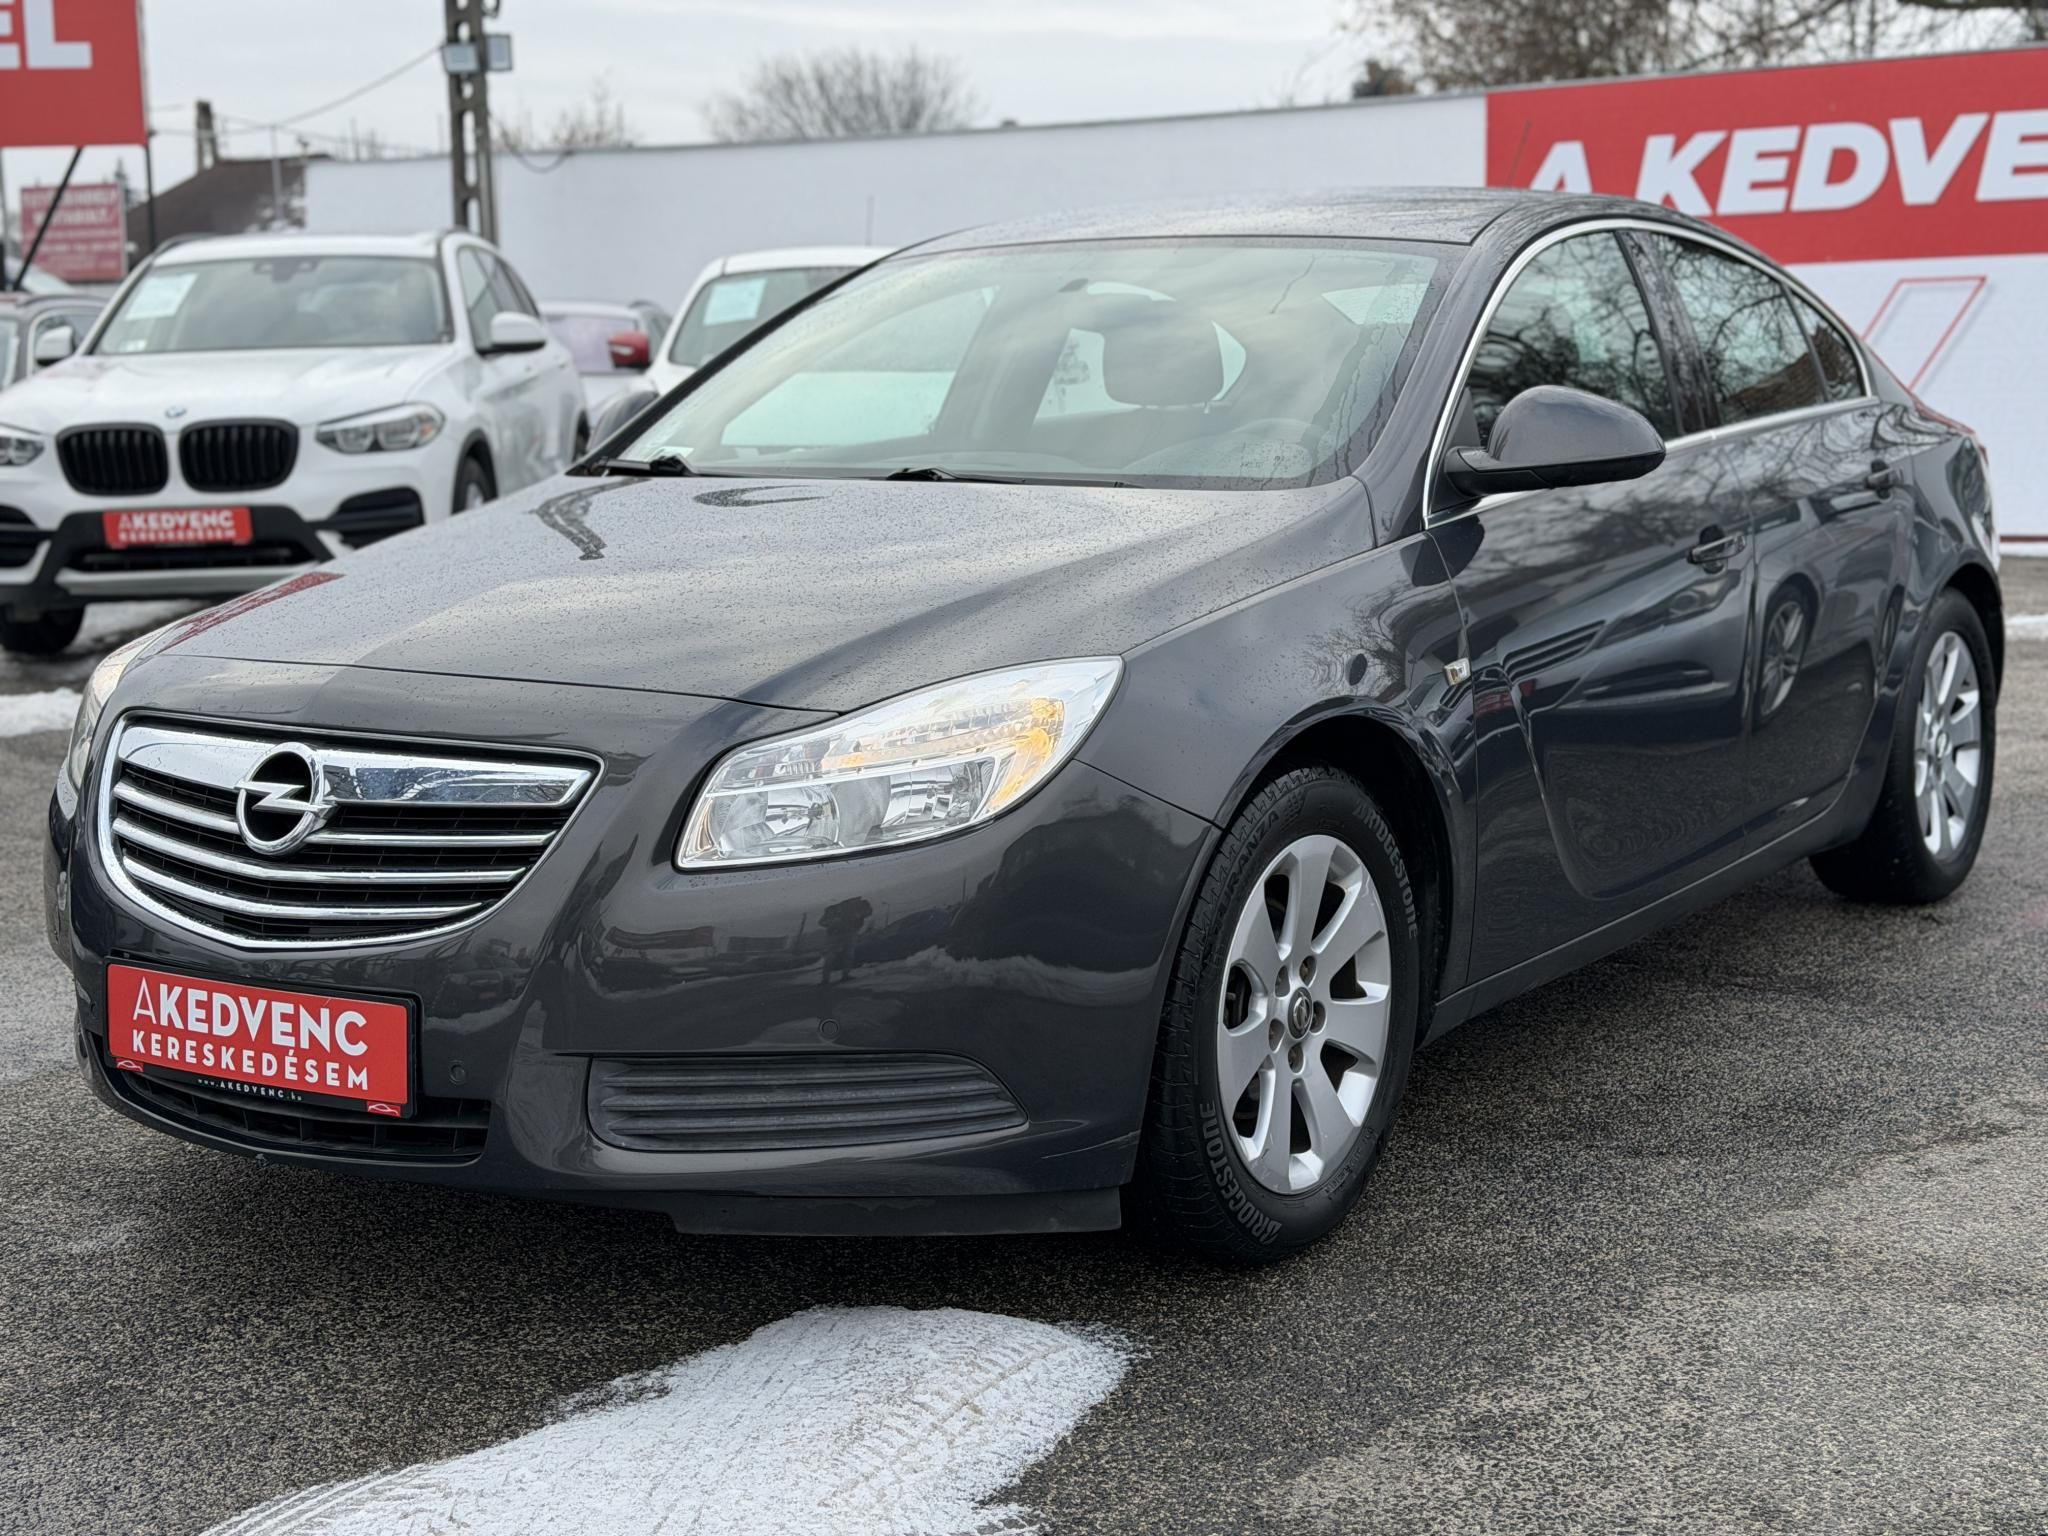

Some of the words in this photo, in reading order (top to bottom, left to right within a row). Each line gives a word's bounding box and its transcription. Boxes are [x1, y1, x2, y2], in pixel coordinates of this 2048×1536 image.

[1529, 140, 1593, 194] A
[1635, 109, 2048, 217] KEDVE
[119, 510, 234, 530] AKEDVENC
[132, 1029, 368, 1090] KERESKEDÉSEM
[1199, 1101, 1283, 1245] BRIDGESTONE
